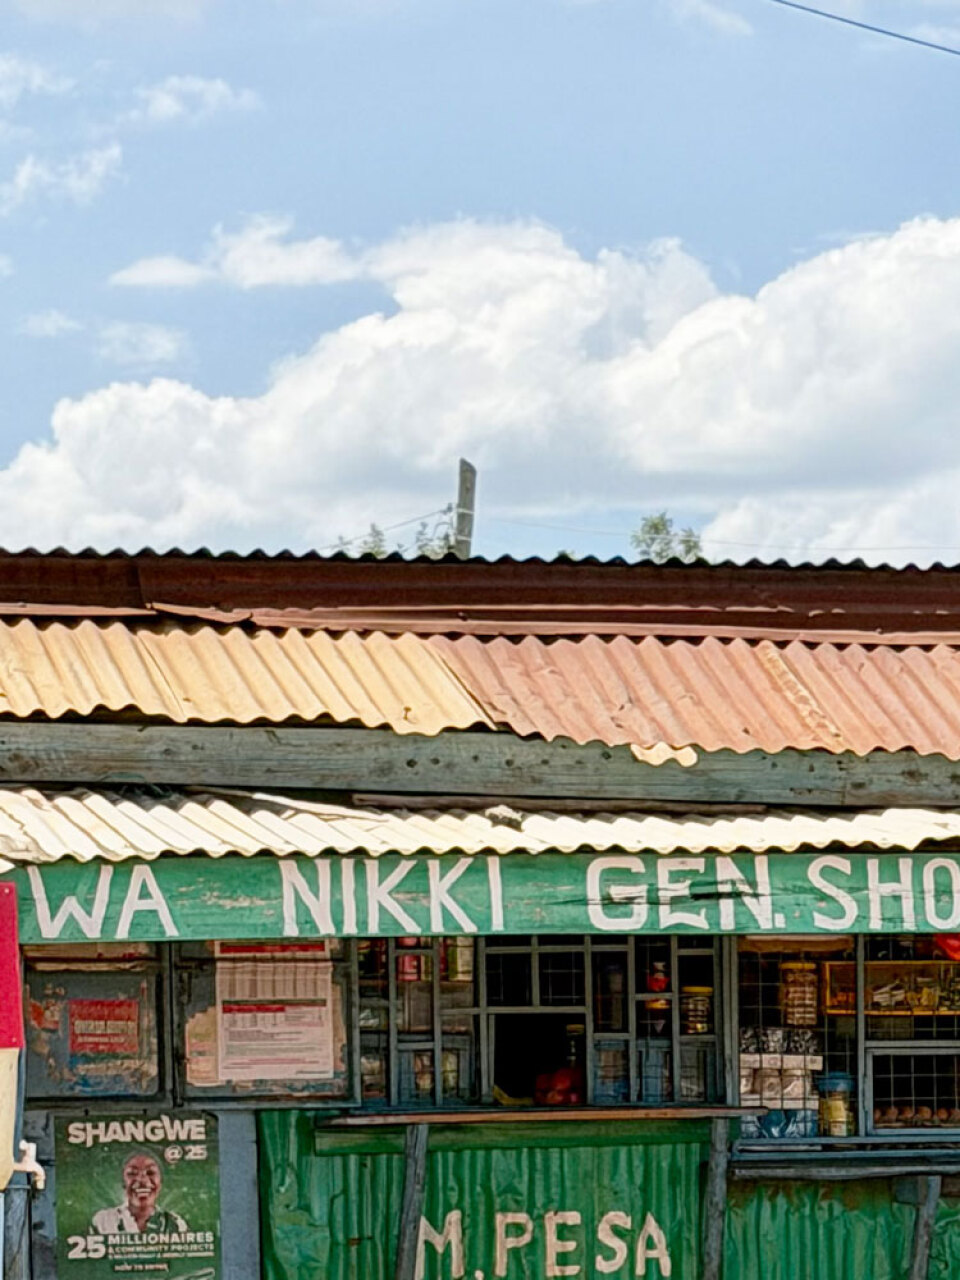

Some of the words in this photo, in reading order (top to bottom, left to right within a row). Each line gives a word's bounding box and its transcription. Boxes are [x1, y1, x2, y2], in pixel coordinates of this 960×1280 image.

[27, 863, 178, 939] WA
[278, 856, 504, 936] NIKKI
[586, 854, 787, 931] GEN.
[68, 1115, 206, 1147] SHANGWE
[164, 1145, 183, 1163] @
[184, 1145, 207, 1160] 25
[67, 1234, 107, 1260] 25
[108, 1231, 214, 1244] MILLIONAIRES
